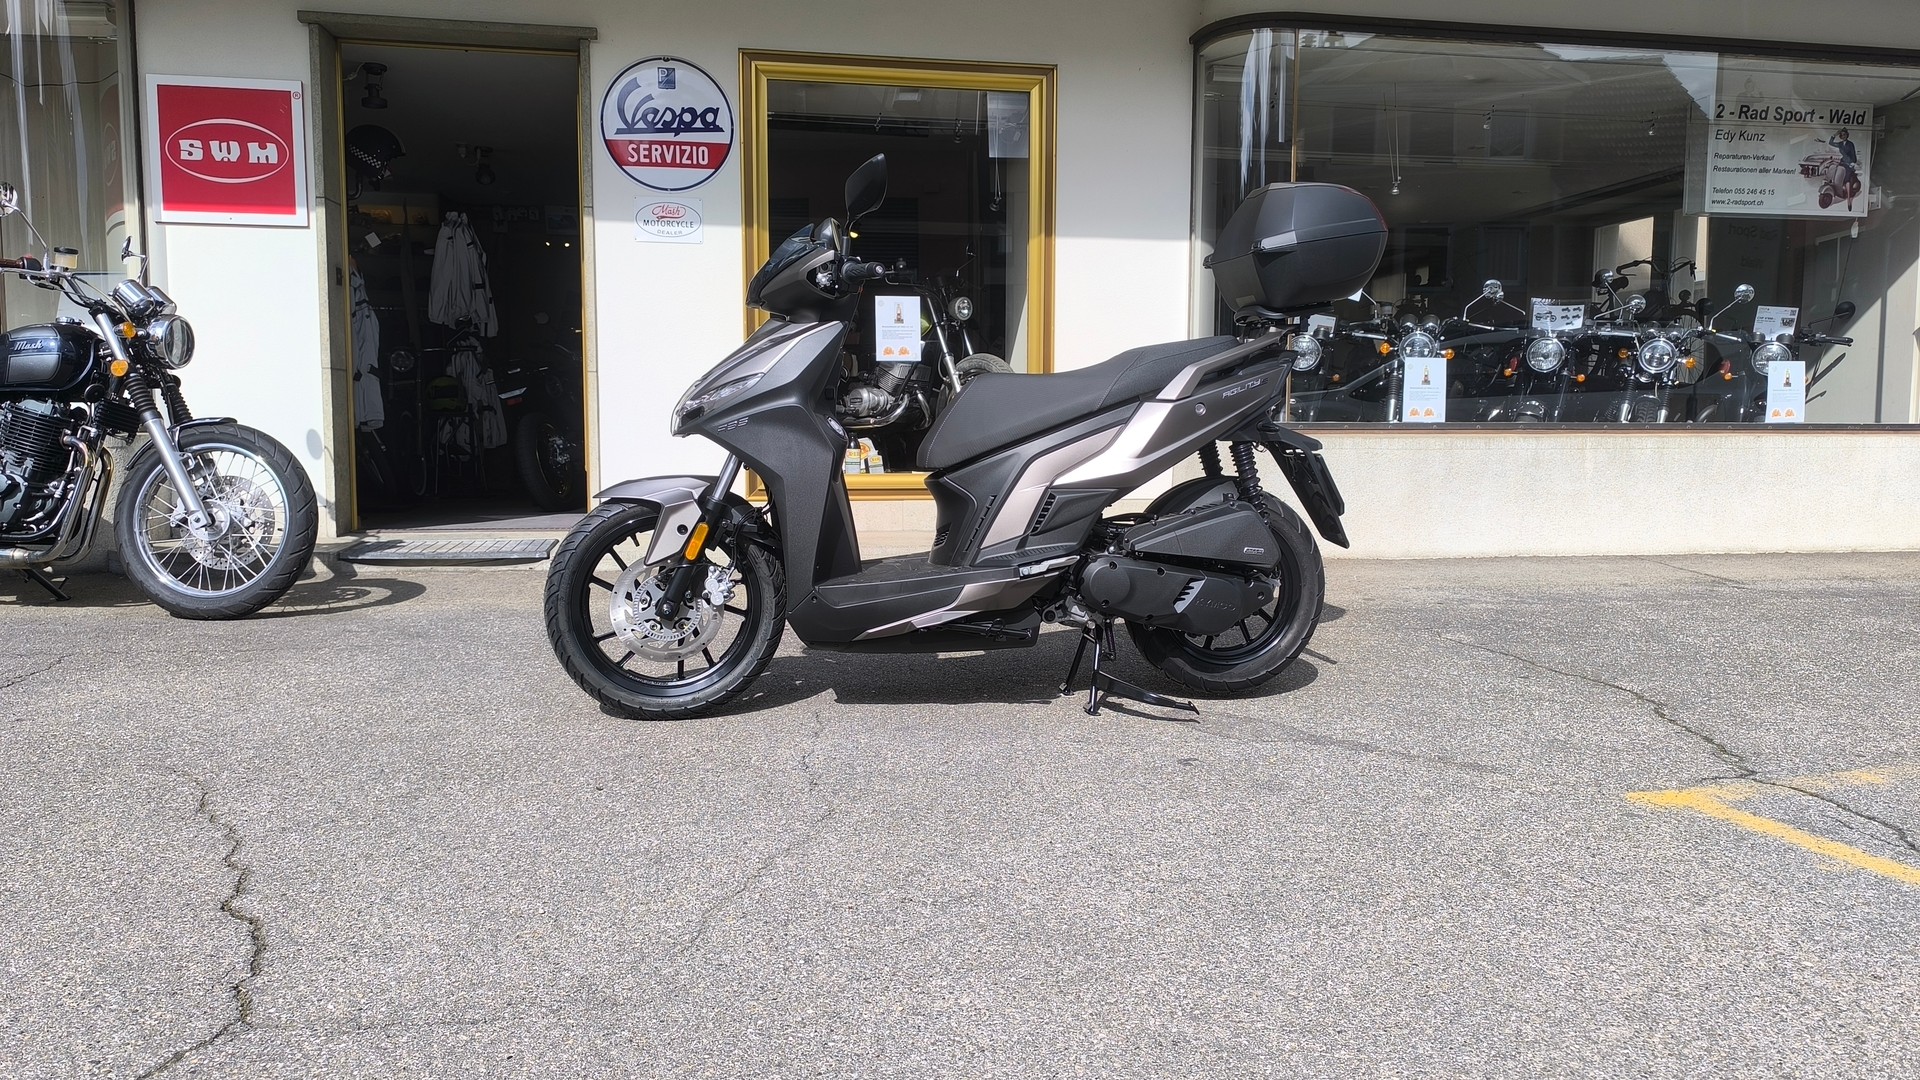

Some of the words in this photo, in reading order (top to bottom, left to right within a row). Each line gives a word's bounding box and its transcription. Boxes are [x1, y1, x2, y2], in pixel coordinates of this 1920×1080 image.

[614, 77, 725, 137] Vespa
[1715, 103, 1726, 119] 2
[1738, 104, 1770, 120] Rad
[1773, 106, 1816, 125] Sport
[1829, 109, 1867, 125] Wald
[1715, 129, 1736, 143] Edy
[1738, 130, 1766, 142] Kunz
[178, 139, 279, 164] SWM
[627, 143, 709, 165] SERVIZIO
[1713, 152, 1776, 161] Reparaturen-Verkauf
[1712, 165, 1758, 173] Restaurationen
[1734, 187, 1746, 195] 055
[1711, 198, 1764, 206] www.2-radsport.ch
[642, 219, 695, 229] MOTORCYCLE
[14, 339, 44, 351] Mash
[1222, 378, 1260, 399] AGILITY
